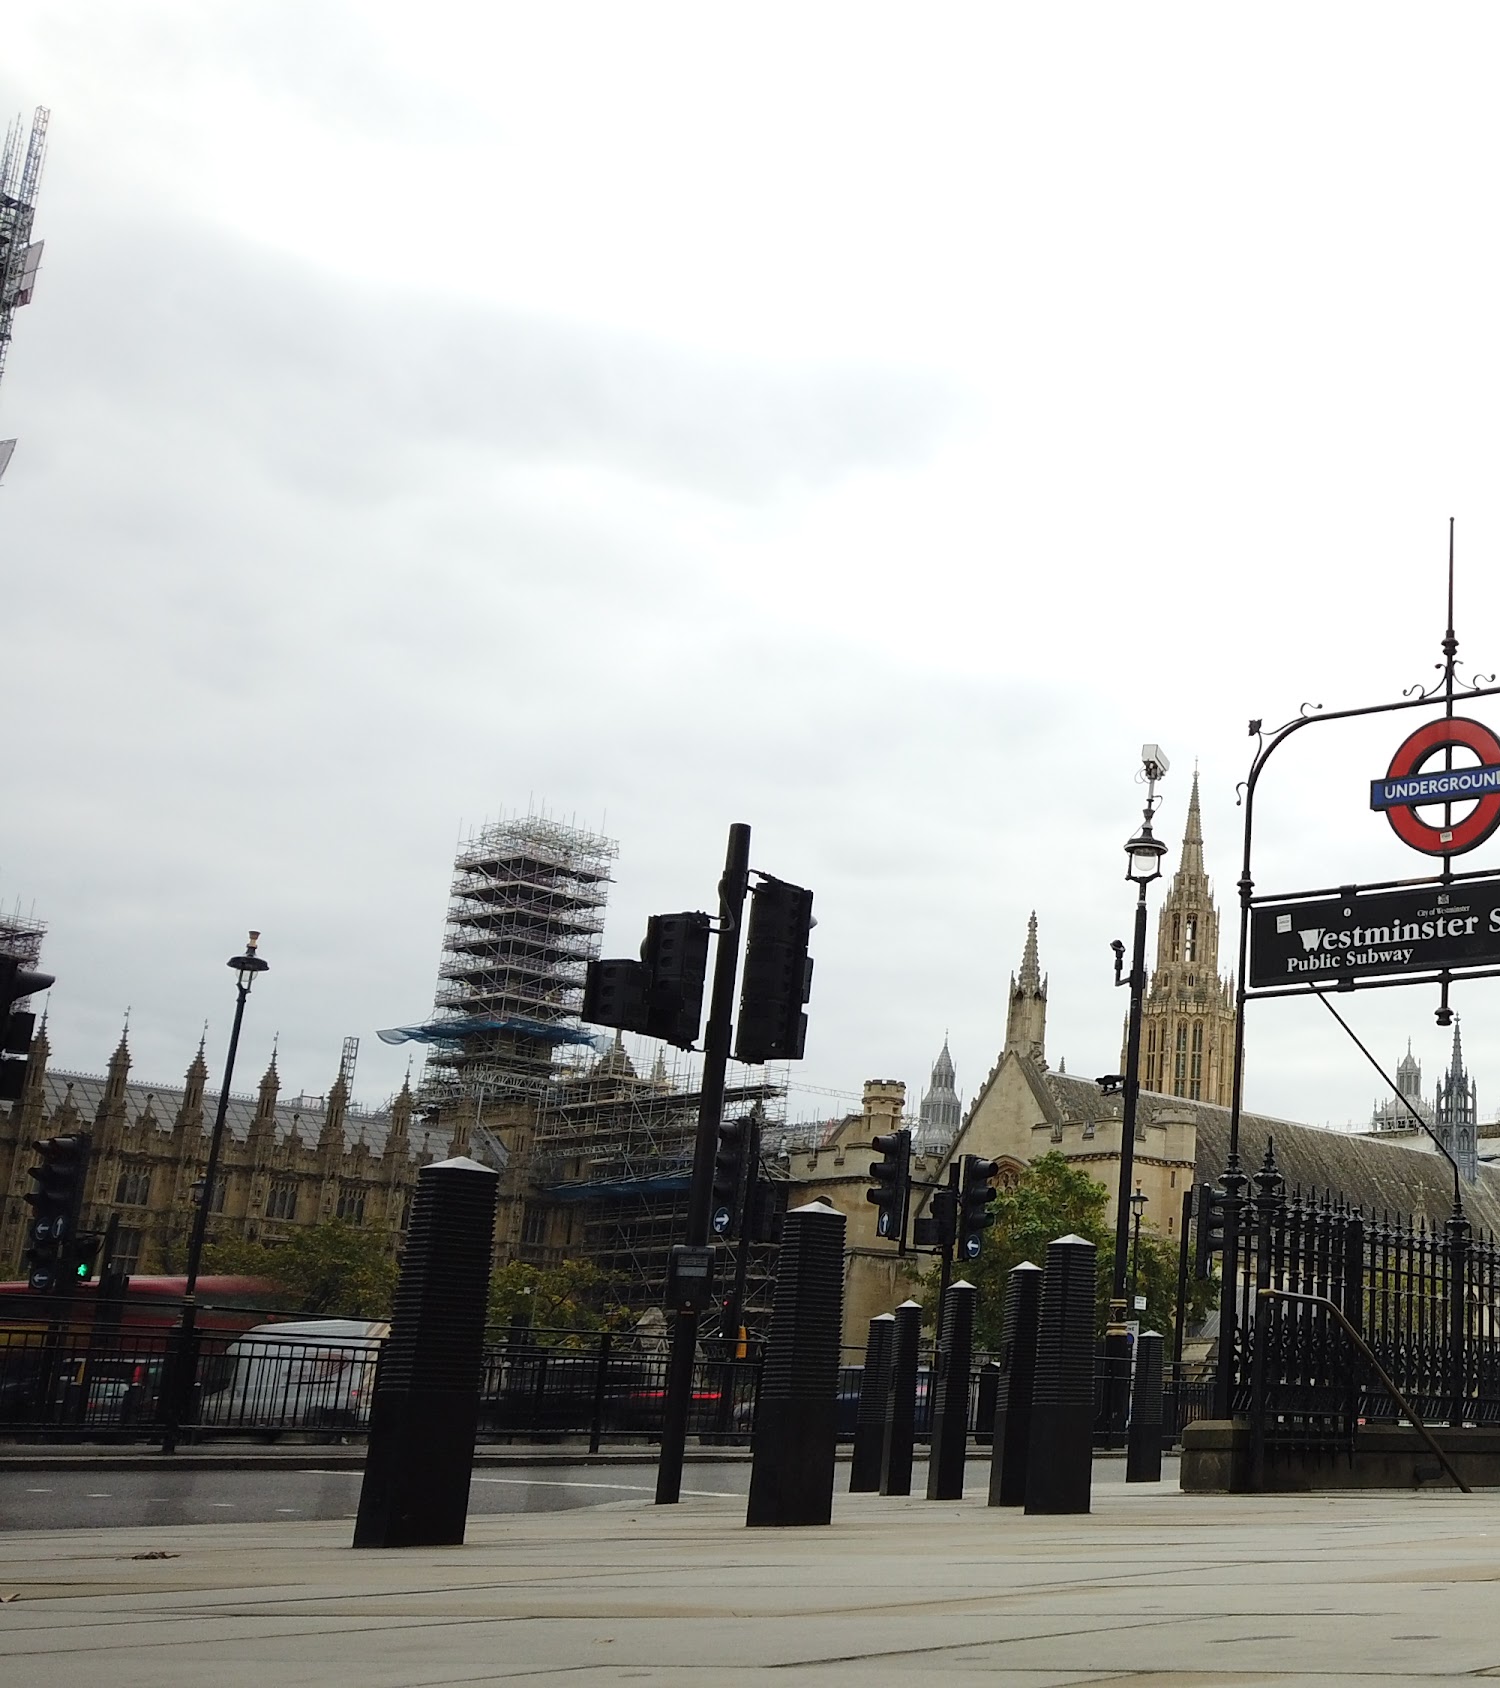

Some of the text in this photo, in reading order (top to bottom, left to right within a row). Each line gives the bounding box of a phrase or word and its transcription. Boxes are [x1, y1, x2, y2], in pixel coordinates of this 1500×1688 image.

[1416, 905, 1470, 918] City of Westminster
[1298, 916, 1479, 952] Westminster
[1287, 948, 1414, 972] Public Subway
